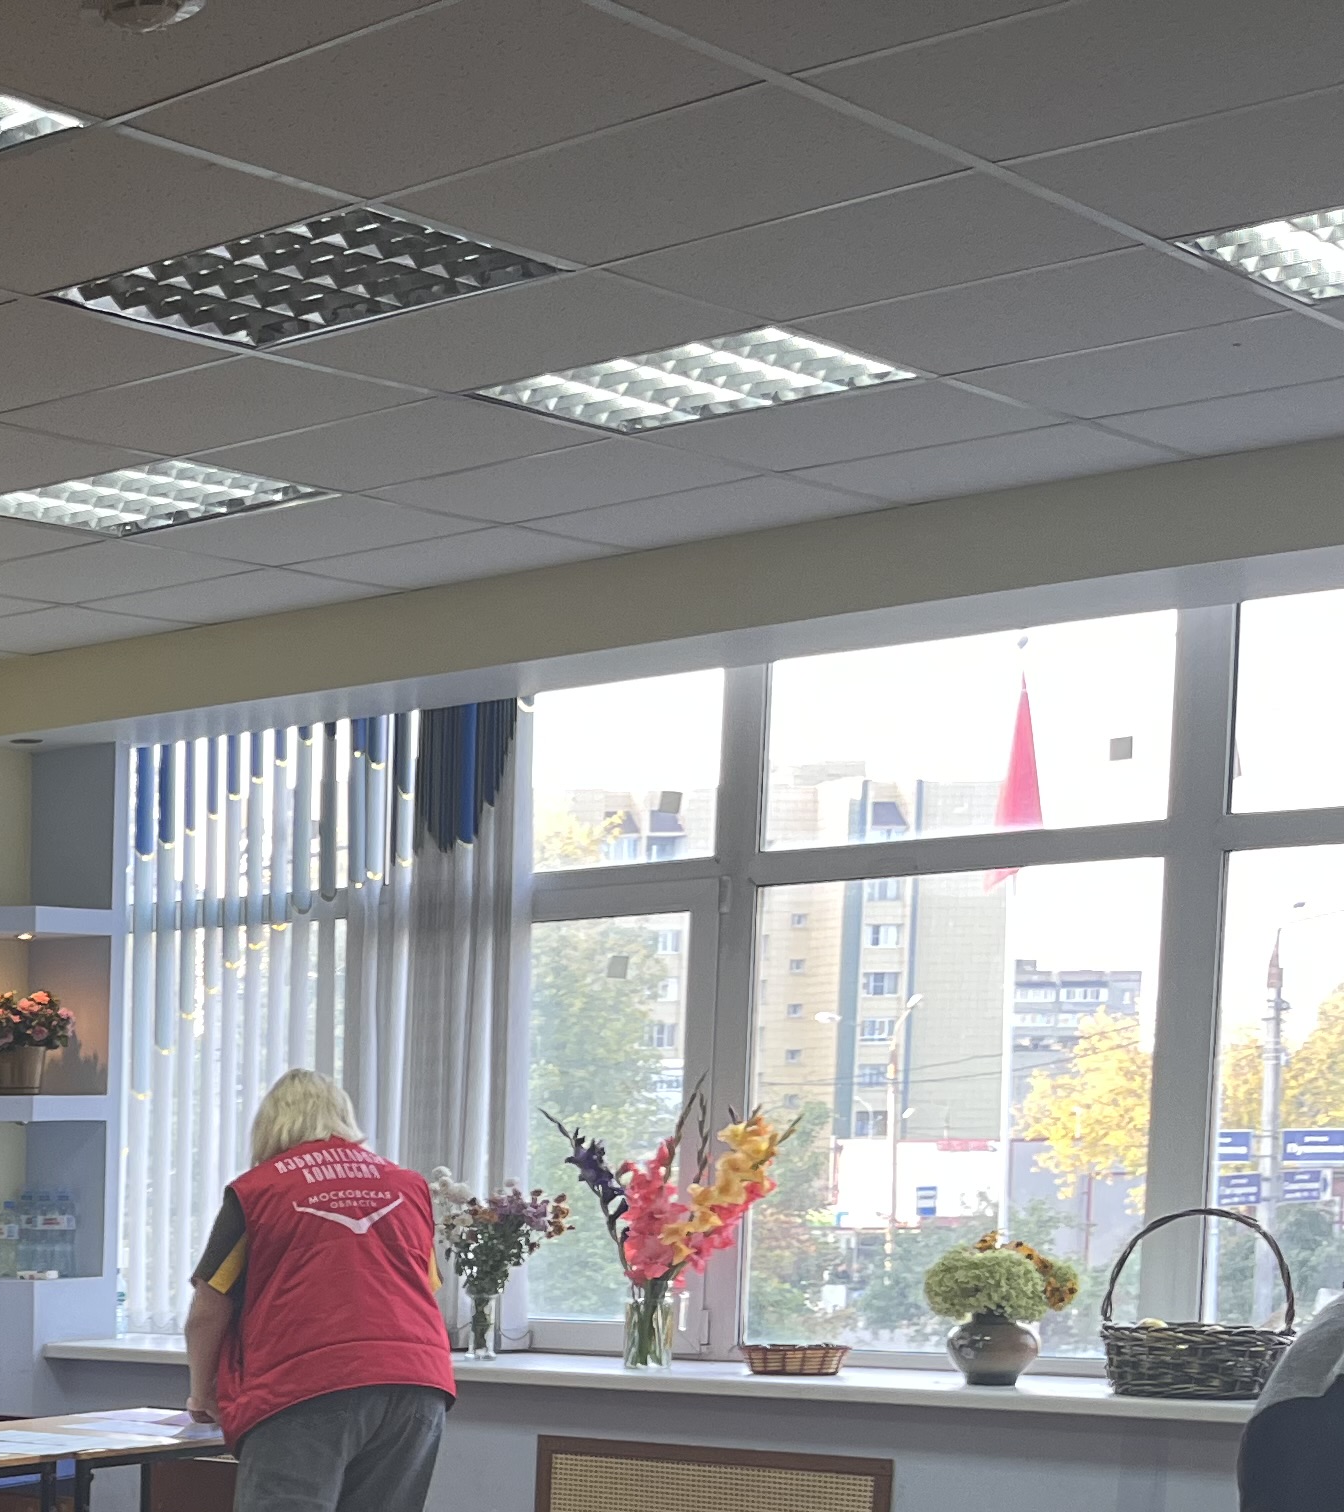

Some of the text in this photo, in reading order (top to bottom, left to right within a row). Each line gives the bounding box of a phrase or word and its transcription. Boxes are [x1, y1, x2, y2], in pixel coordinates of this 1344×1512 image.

[301, 1162, 381, 1184] КОМИССИЯ
[307, 1189, 392, 1205] МОСКОВСКАЯ
[329, 1199, 377, 1209] ОБЛАСТЬ
